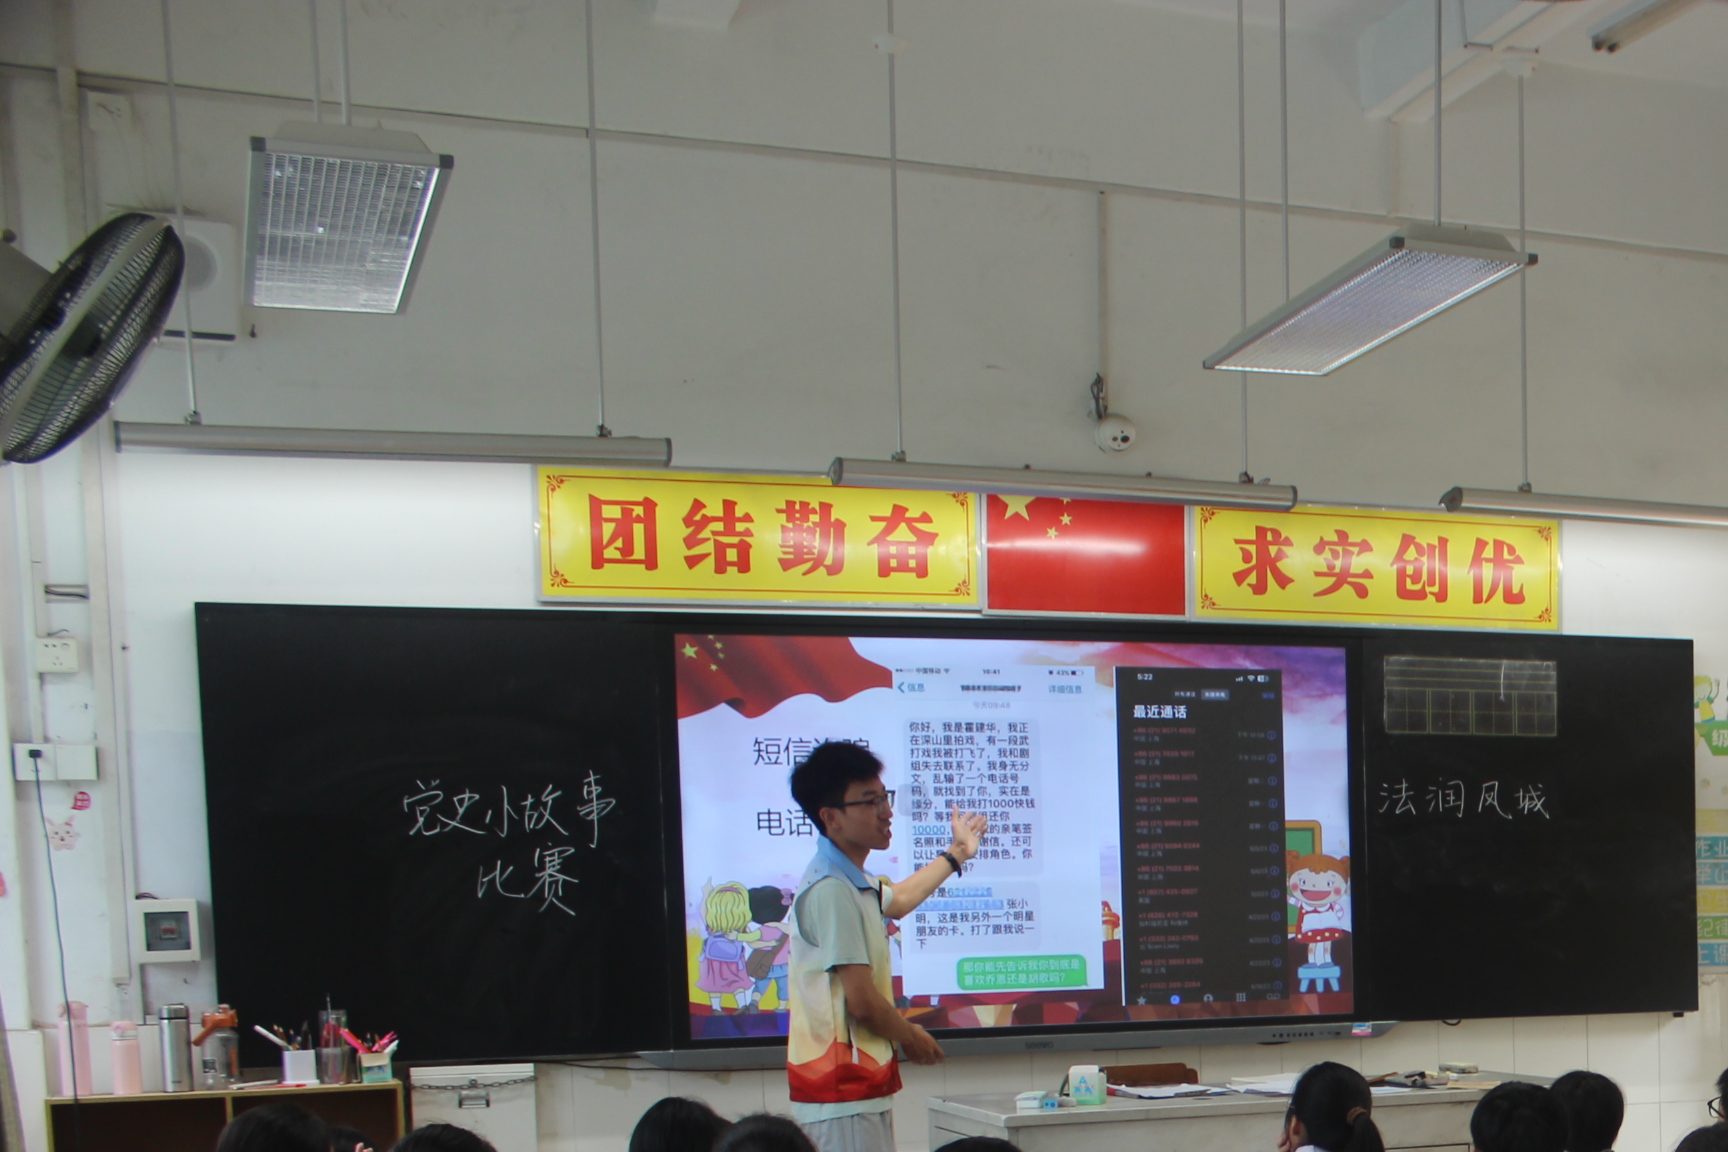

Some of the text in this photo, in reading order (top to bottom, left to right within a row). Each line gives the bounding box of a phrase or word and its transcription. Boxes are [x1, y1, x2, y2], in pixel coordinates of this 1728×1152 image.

[588, 493, 940, 580] 团结勤奋
[1232, 524, 1527, 606] 求实创优
[907, 683, 925, 693] 信息
[1133, 704, 1187, 720] 最近通话
[403, 769, 616, 848] 党史小故事
[757, 808, 813, 837] 电话
[478, 842, 579, 916] 比赛
[916, 938, 927, 950] 下
